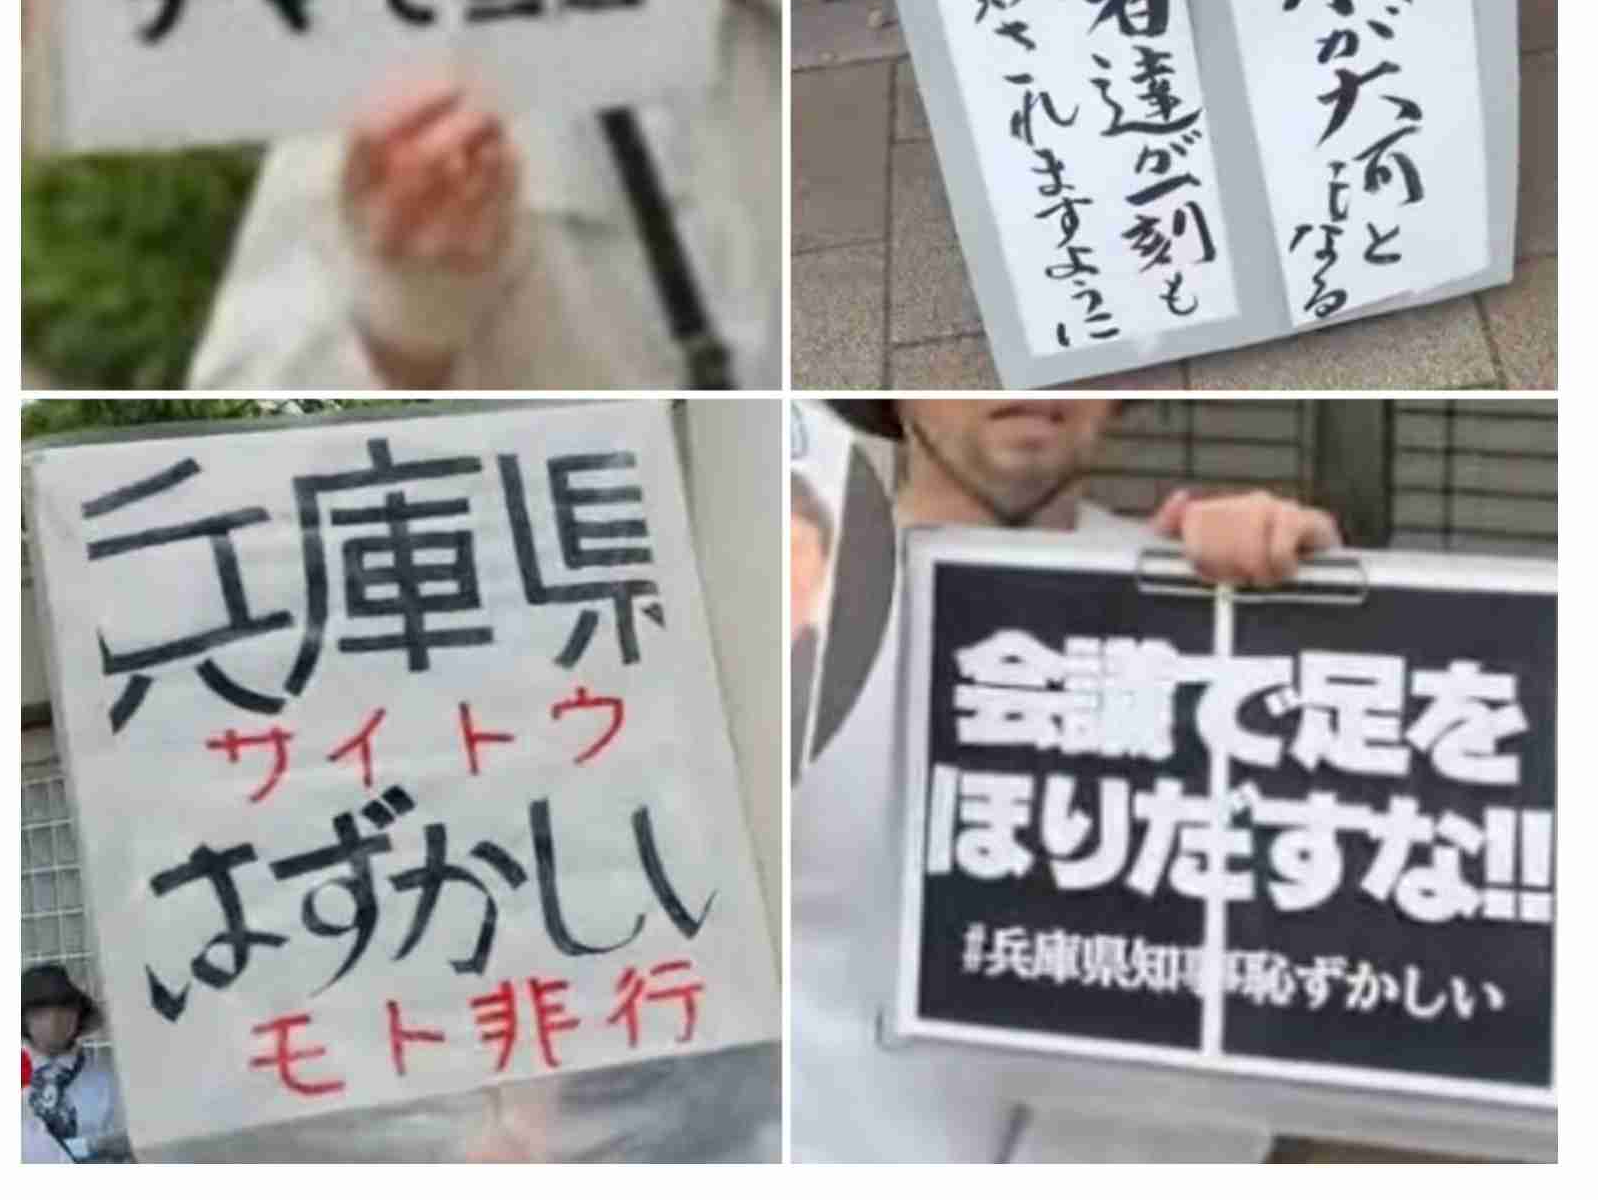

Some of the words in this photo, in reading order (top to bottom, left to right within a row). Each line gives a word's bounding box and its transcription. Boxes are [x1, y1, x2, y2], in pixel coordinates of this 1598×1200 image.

[81, 437, 666, 734] 兵庫県
[206, 686, 624, 804] サイトウ
[954, 629, 1529, 786] 会議で足を
[248, 959, 705, 1098] モト非行
